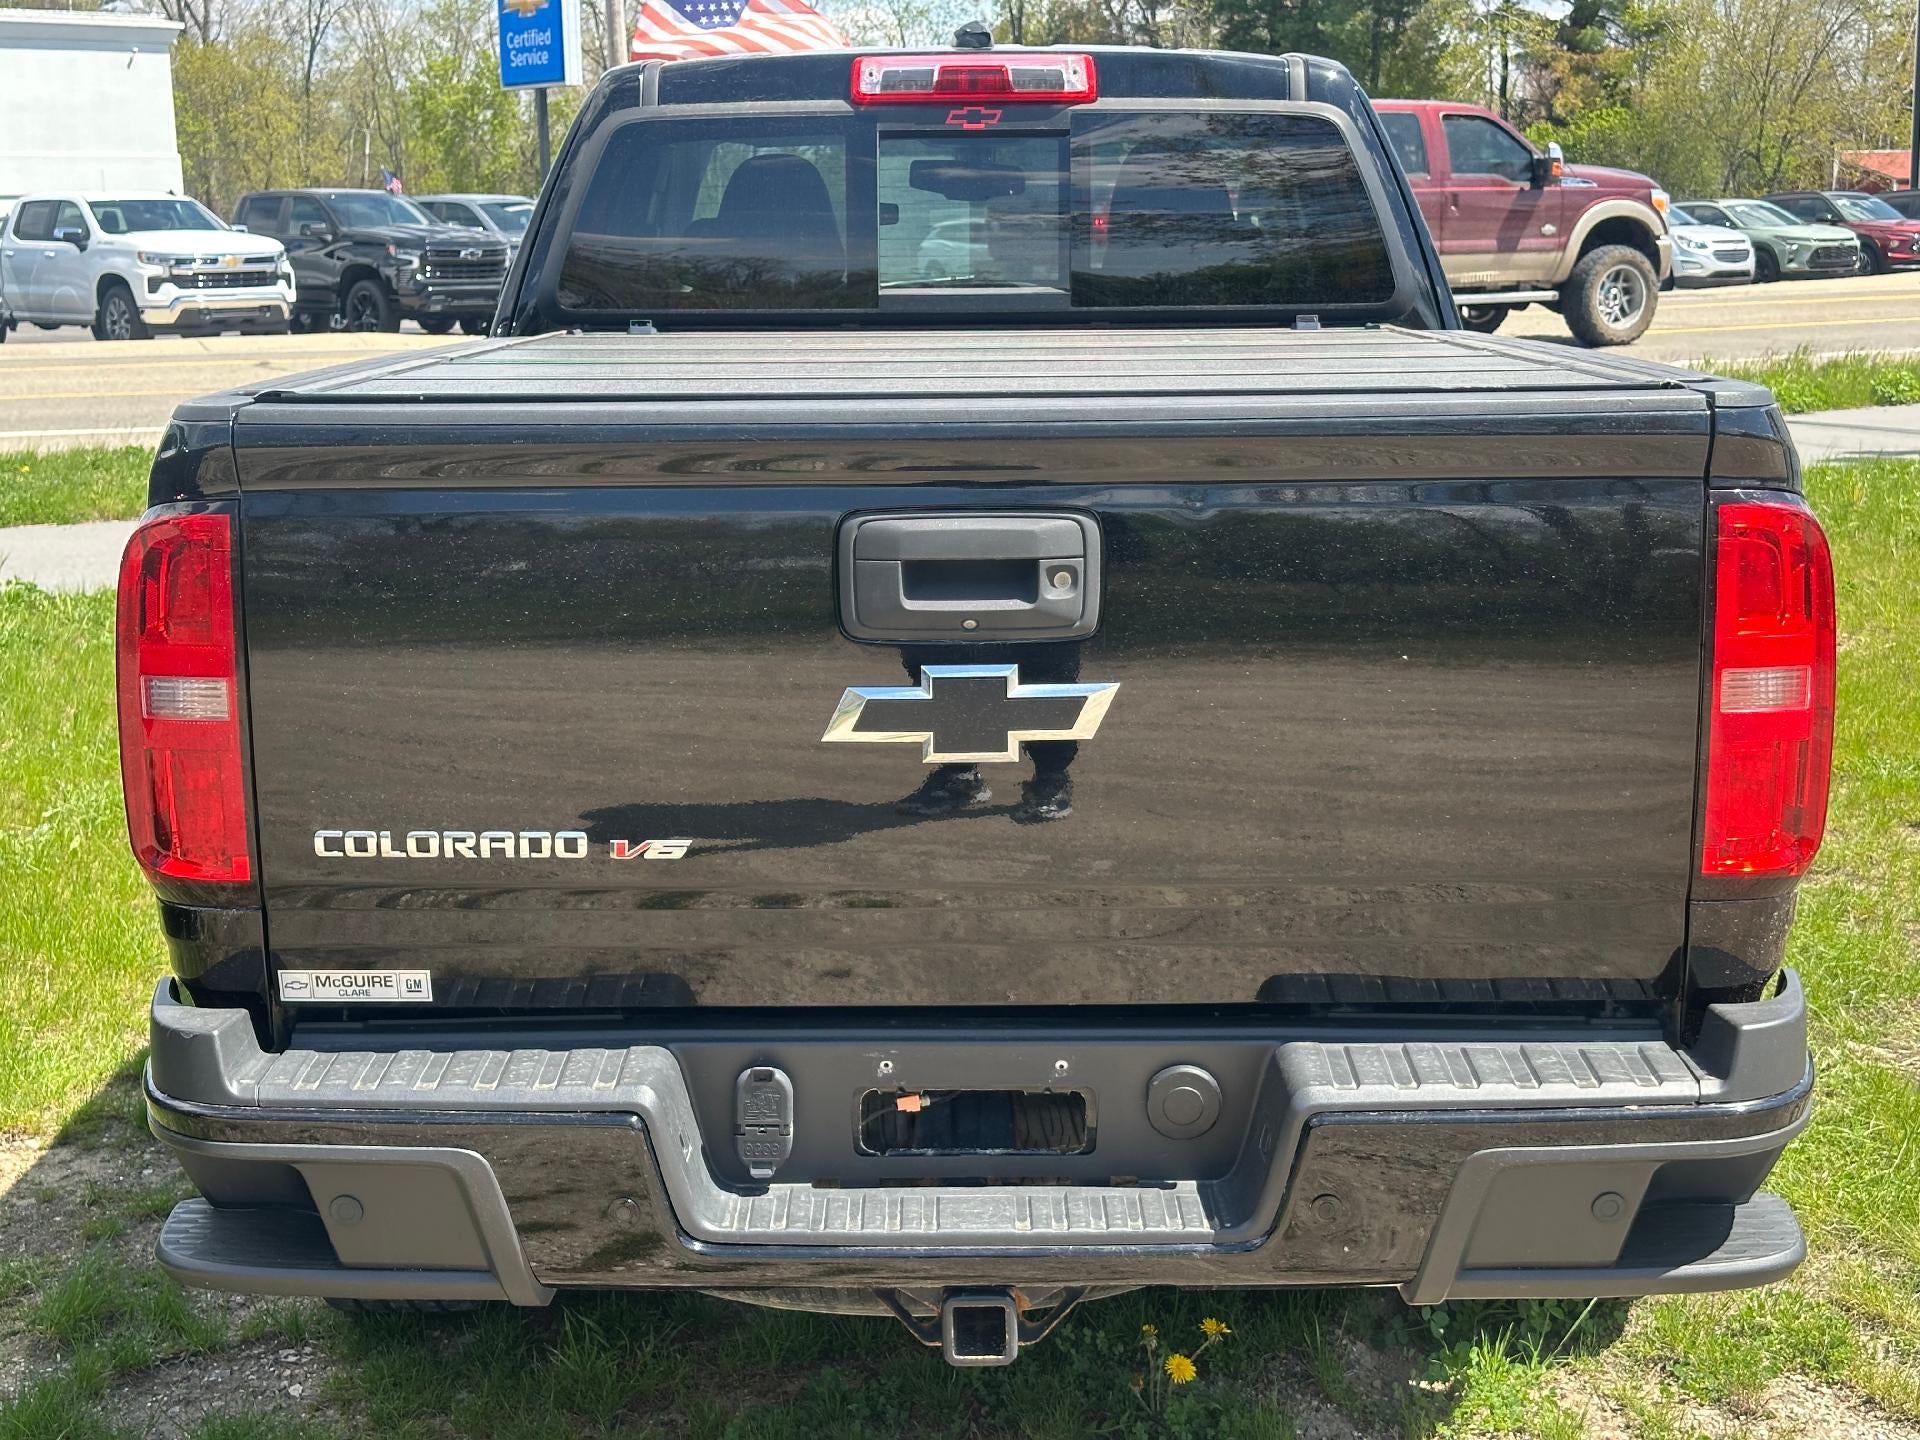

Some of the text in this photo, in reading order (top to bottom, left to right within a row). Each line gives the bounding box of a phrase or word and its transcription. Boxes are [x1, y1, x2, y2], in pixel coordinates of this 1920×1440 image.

[506, 28, 551, 49] Certified
[510, 49, 549, 67] Service
[314, 830, 693, 859] COLORADO V6
[315, 975, 394, 988] McGUIRE
[406, 978, 422, 990] GM
[338, 989, 371, 997] CLARE
